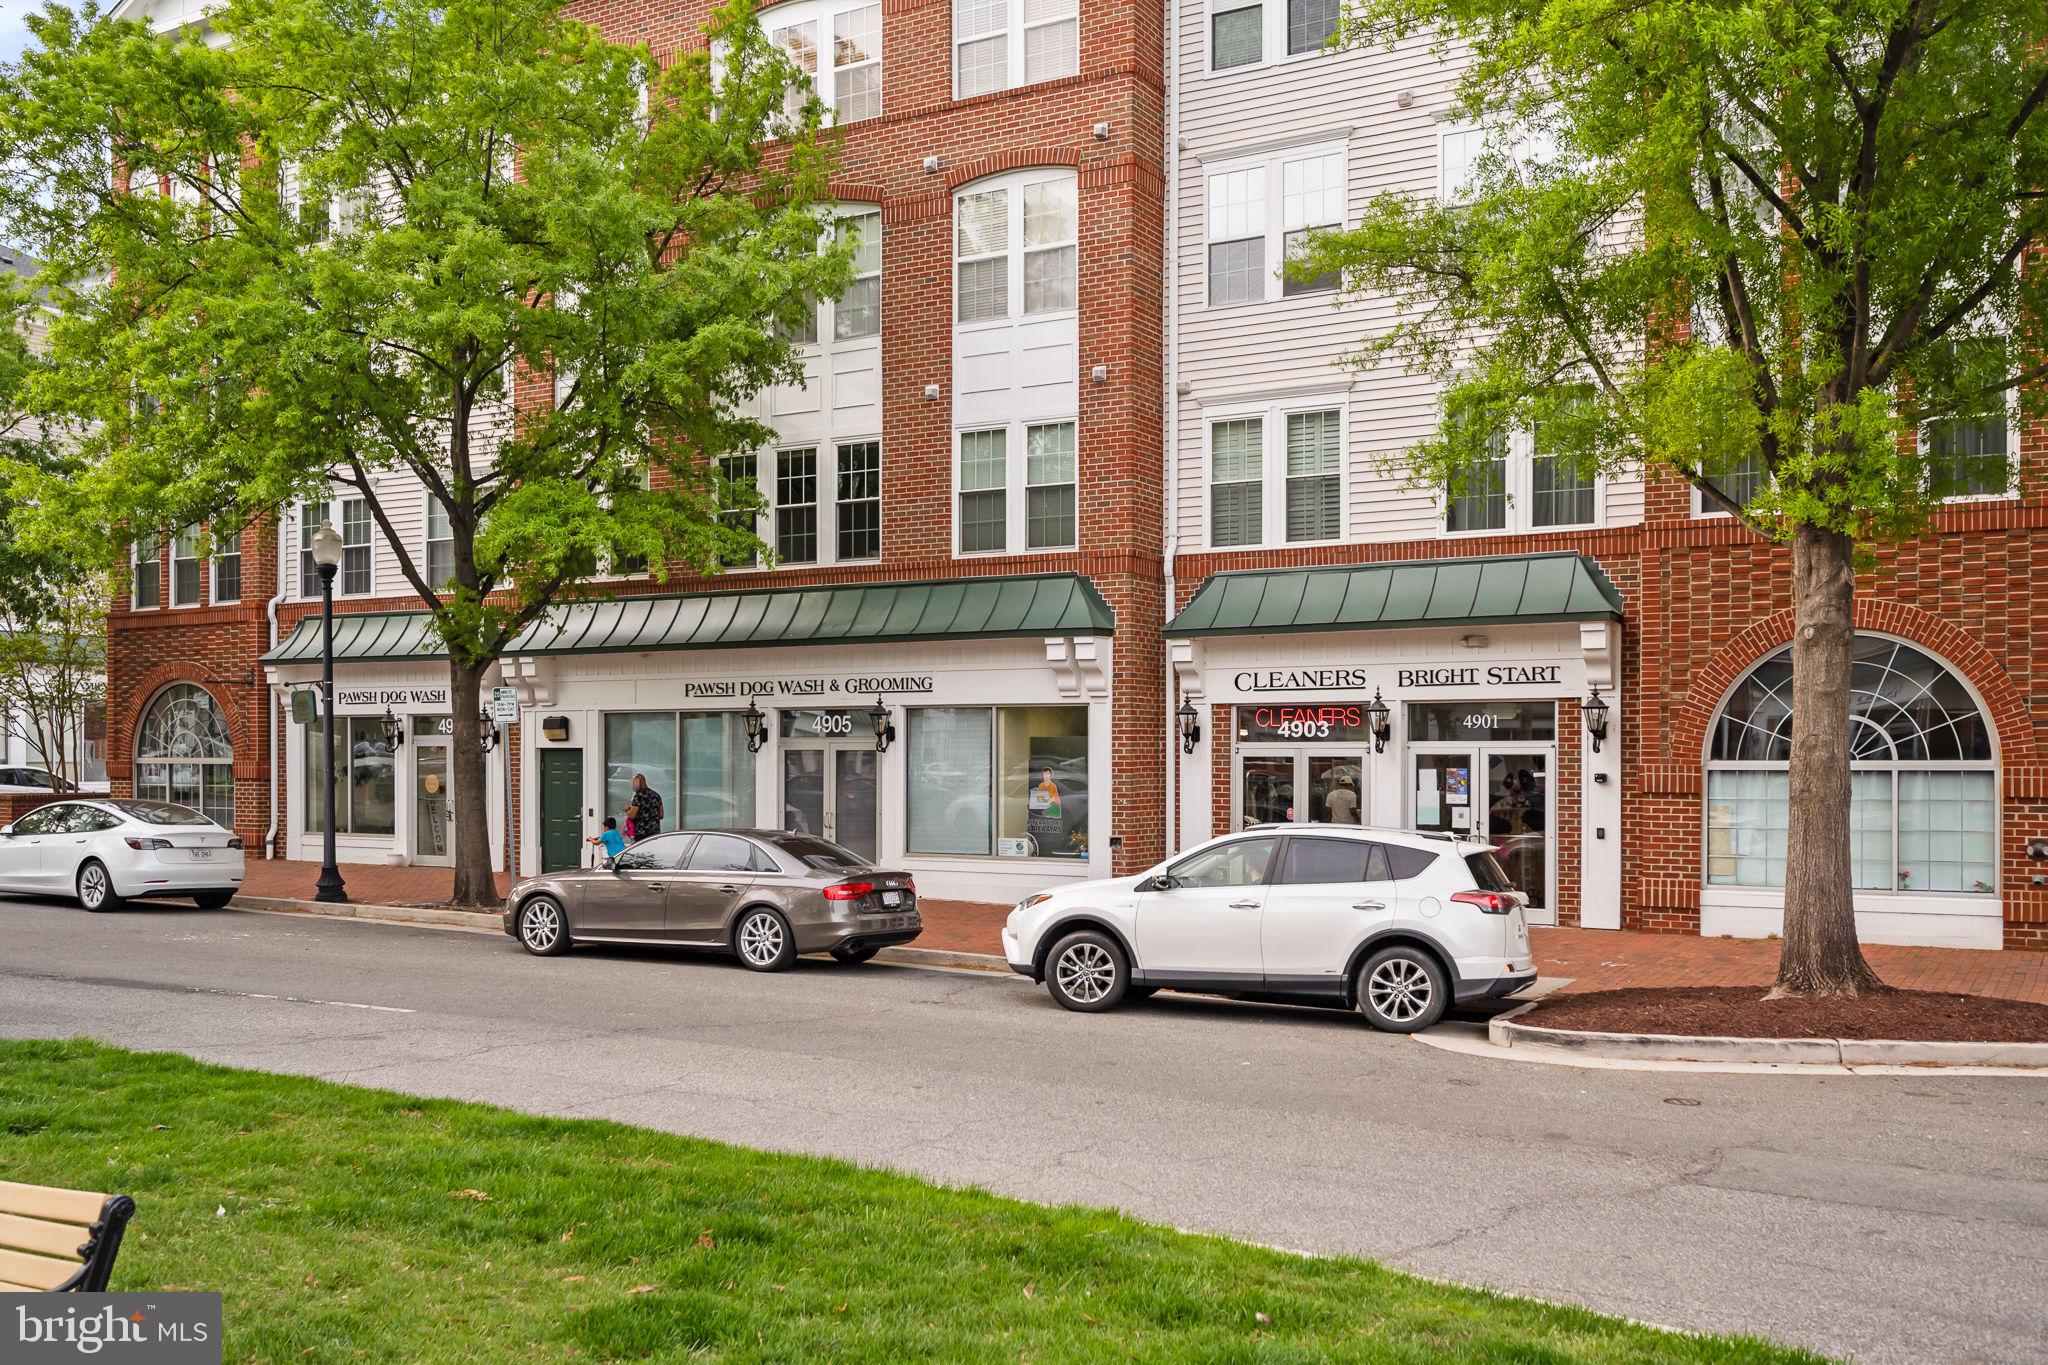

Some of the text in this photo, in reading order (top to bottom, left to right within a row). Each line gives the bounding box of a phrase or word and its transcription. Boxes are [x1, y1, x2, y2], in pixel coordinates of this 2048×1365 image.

[1234, 668, 1366, 692] CLEANERS
[1398, 666, 1561, 688] BRIGHT START
[684, 676, 933, 698] PAWSH DOG WASH & GROOMING
[338, 690, 446, 705] PAWSH DOG WASH
[438, 718, 454, 734] 49
[812, 715, 852, 733] 4905
[1255, 707, 1361, 727] CLEANERS
[1462, 714, 1499, 729] 4901
[1277, 720, 1330, 738] 4903
